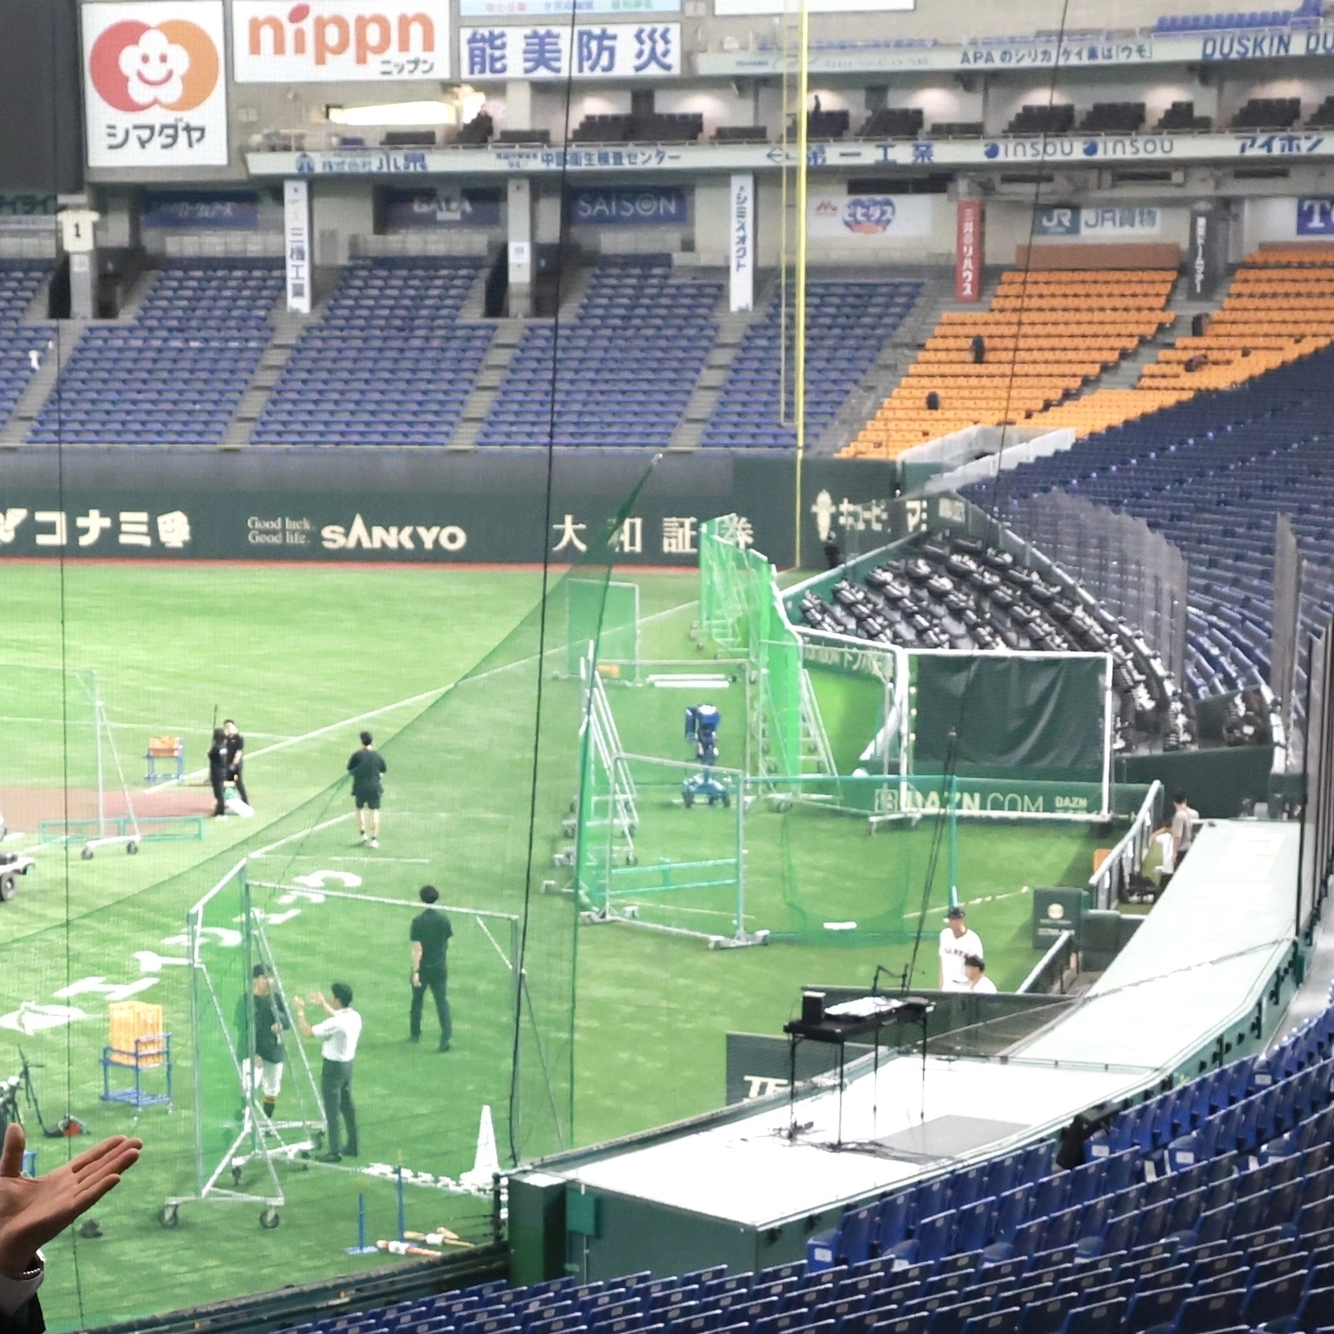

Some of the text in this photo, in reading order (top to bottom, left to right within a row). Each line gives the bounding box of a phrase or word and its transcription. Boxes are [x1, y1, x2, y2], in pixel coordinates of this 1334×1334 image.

[248, 4, 435, 65] nippn
[1202, 34, 1291, 59] DUSKIN
[467, 27, 673, 74] 能美防災
[380, 59, 434, 76] ニップン
[106, 123, 206, 150] シマダヤ
[1235, 133, 1325, 154] アイホン
[578, 192, 677, 217] SAISON
[34, 508, 152, 547] コナミ
[247, 516, 282, 530] Good
[320, 512, 467, 551] SANKYO
[247, 530, 282, 544] Good
